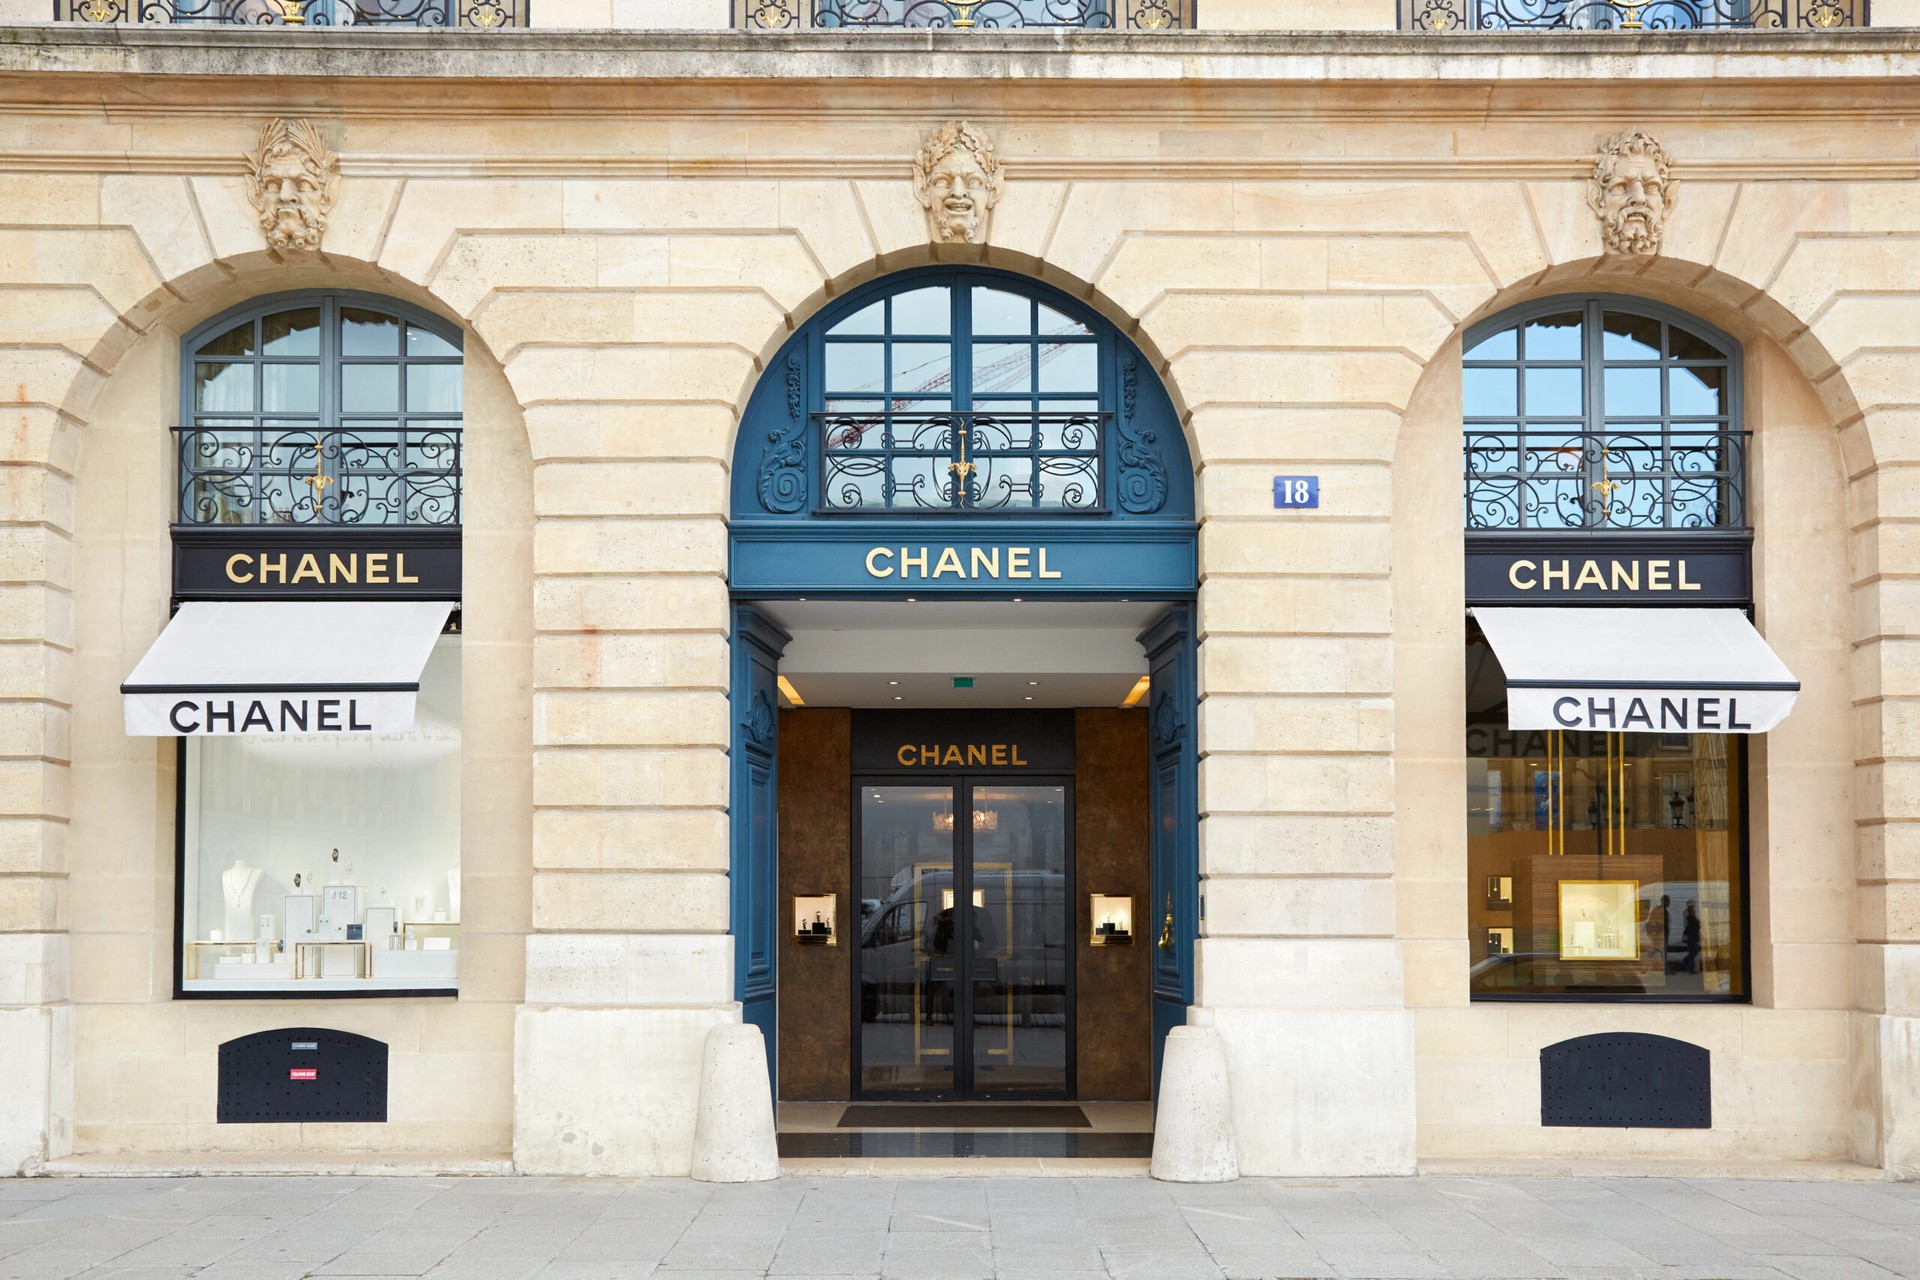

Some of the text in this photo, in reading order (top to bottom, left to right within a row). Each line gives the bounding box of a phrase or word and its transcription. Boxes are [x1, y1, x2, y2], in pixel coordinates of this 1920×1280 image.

[1284, 480, 1310, 504] 18
[225, 553, 419, 584] CHANEL
[866, 547, 1062, 579] CHANEL
[1508, 559, 1701, 590] CHANEL
[169, 700, 372, 732] CHANEL
[1552, 696, 1752, 730] CHANEL
[897, 744, 1028, 766] CHANEL
[338, 889, 348, 900] 12
